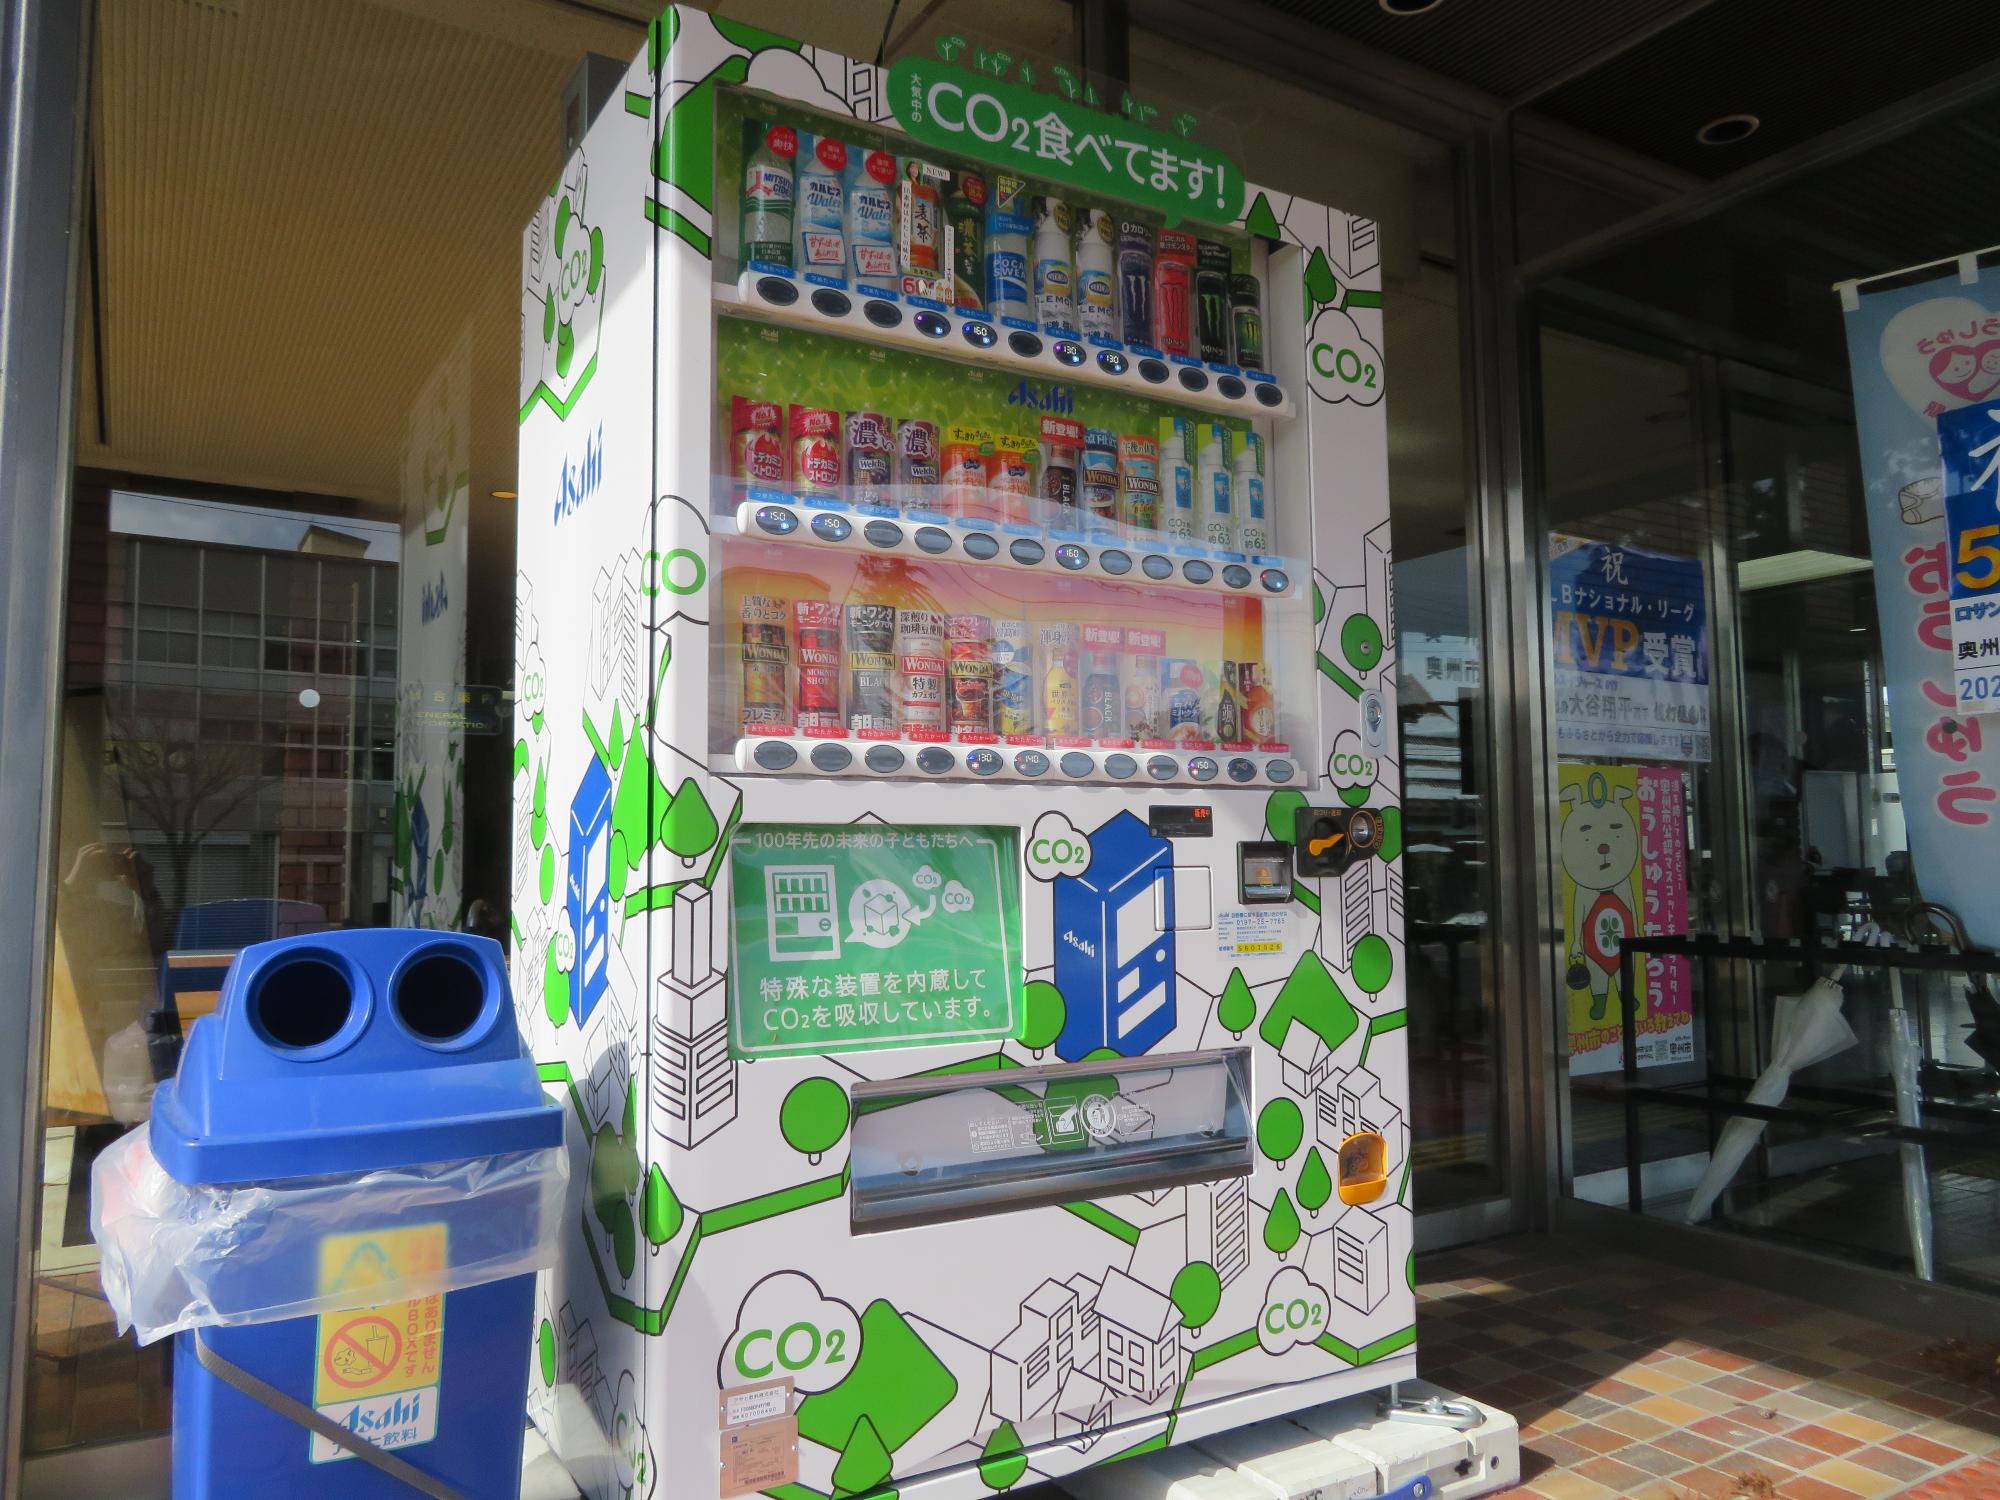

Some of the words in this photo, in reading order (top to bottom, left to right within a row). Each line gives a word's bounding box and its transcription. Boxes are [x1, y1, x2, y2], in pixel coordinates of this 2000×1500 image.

[910, 72, 923, 123] 大気中の
[927, 81, 1226, 209] CO2食べてます!
[925, 165, 949, 178] NEW!
[914, 203, 934, 244] 麦茶
[561, 248, 588, 301] CO2
[973, 325, 988, 337] 160
[1064, 345, 1077, 355] 130
[1106, 354, 1119, 364] 130
[1312, 342, 1377, 390] CO2
[1007, 378, 1074, 417] Asahi
[553, 418, 604, 528] Asahi
[1086, 470, 1118, 486] WONDA
[1128, 476, 1158, 492] WONDA
[1062, 484, 1072, 514] BLACK
[770, 511, 786, 522] 150
[824, 518, 841, 529] 150
[1066, 548, 1080, 558] 160
[1601, 545, 1629, 586] 祝
[1551, 583, 1695, 623] Bナショナル・リーグ
[746, 645, 786, 661] WONDA
[855, 652, 893, 668] WONDA
[1957, 636, 2000, 661] 奥州
[905, 656, 942, 672] WONDA
[954, 661, 992, 674] WONDA
[524, 672, 545, 702] CO2
[912, 676, 938, 691] 特製
[977, 753, 992, 763] 130
[1025, 754, 1039, 764] 140
[1197, 761, 1209, 770] 150
[1333, 753, 1373, 776] CO2
[755, 831, 975, 850] 100年先の未来の子どもたちへ
[1032, 838, 1085, 866] CO2
[915, 873, 938, 885] CO2
[944, 891, 971, 906] CO2
[557, 930, 574, 961] CO2
[1063, 930, 1096, 958] Asahi
[759, 967, 987, 1003] 特殊な装置を内蔵して
[763, 996, 991, 1031] CO2を吸収しています。
[1264, 1298, 1323, 1335] CO2
[734, 1321, 846, 1379] CO2
[338, 1392, 421, 1434] Asahi
